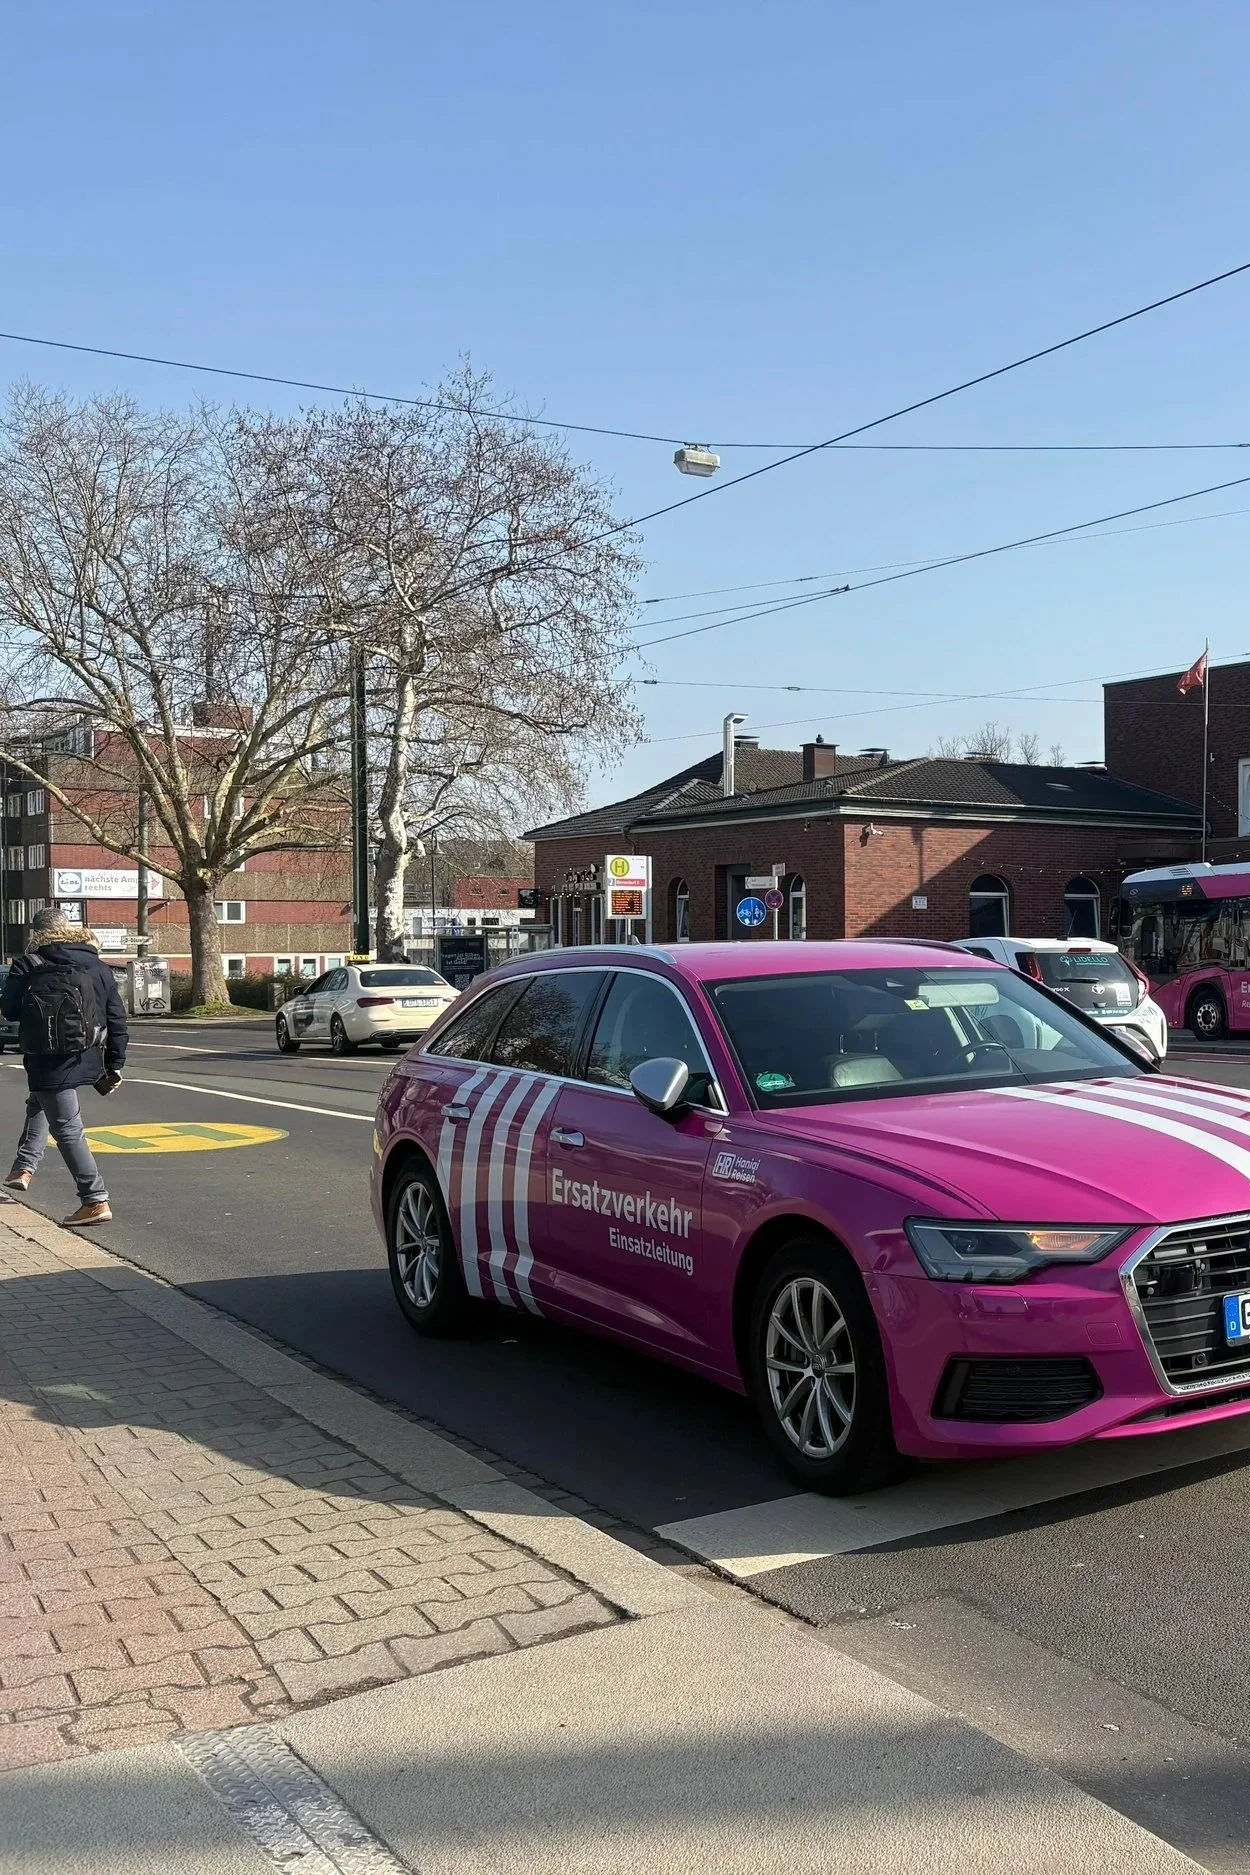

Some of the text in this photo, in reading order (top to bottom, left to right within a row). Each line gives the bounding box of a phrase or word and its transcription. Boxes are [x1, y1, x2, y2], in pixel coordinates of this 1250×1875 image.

[84, 875, 119, 883] nächste
[714, 1155, 732, 1175] HR
[731, 1168, 756, 1184] Reisen
[552, 1167, 693, 1239] Ersatzverkehr
[608, 1226, 694, 1276] Einsatzleitung
[1230, 1321, 1237, 1331] D
